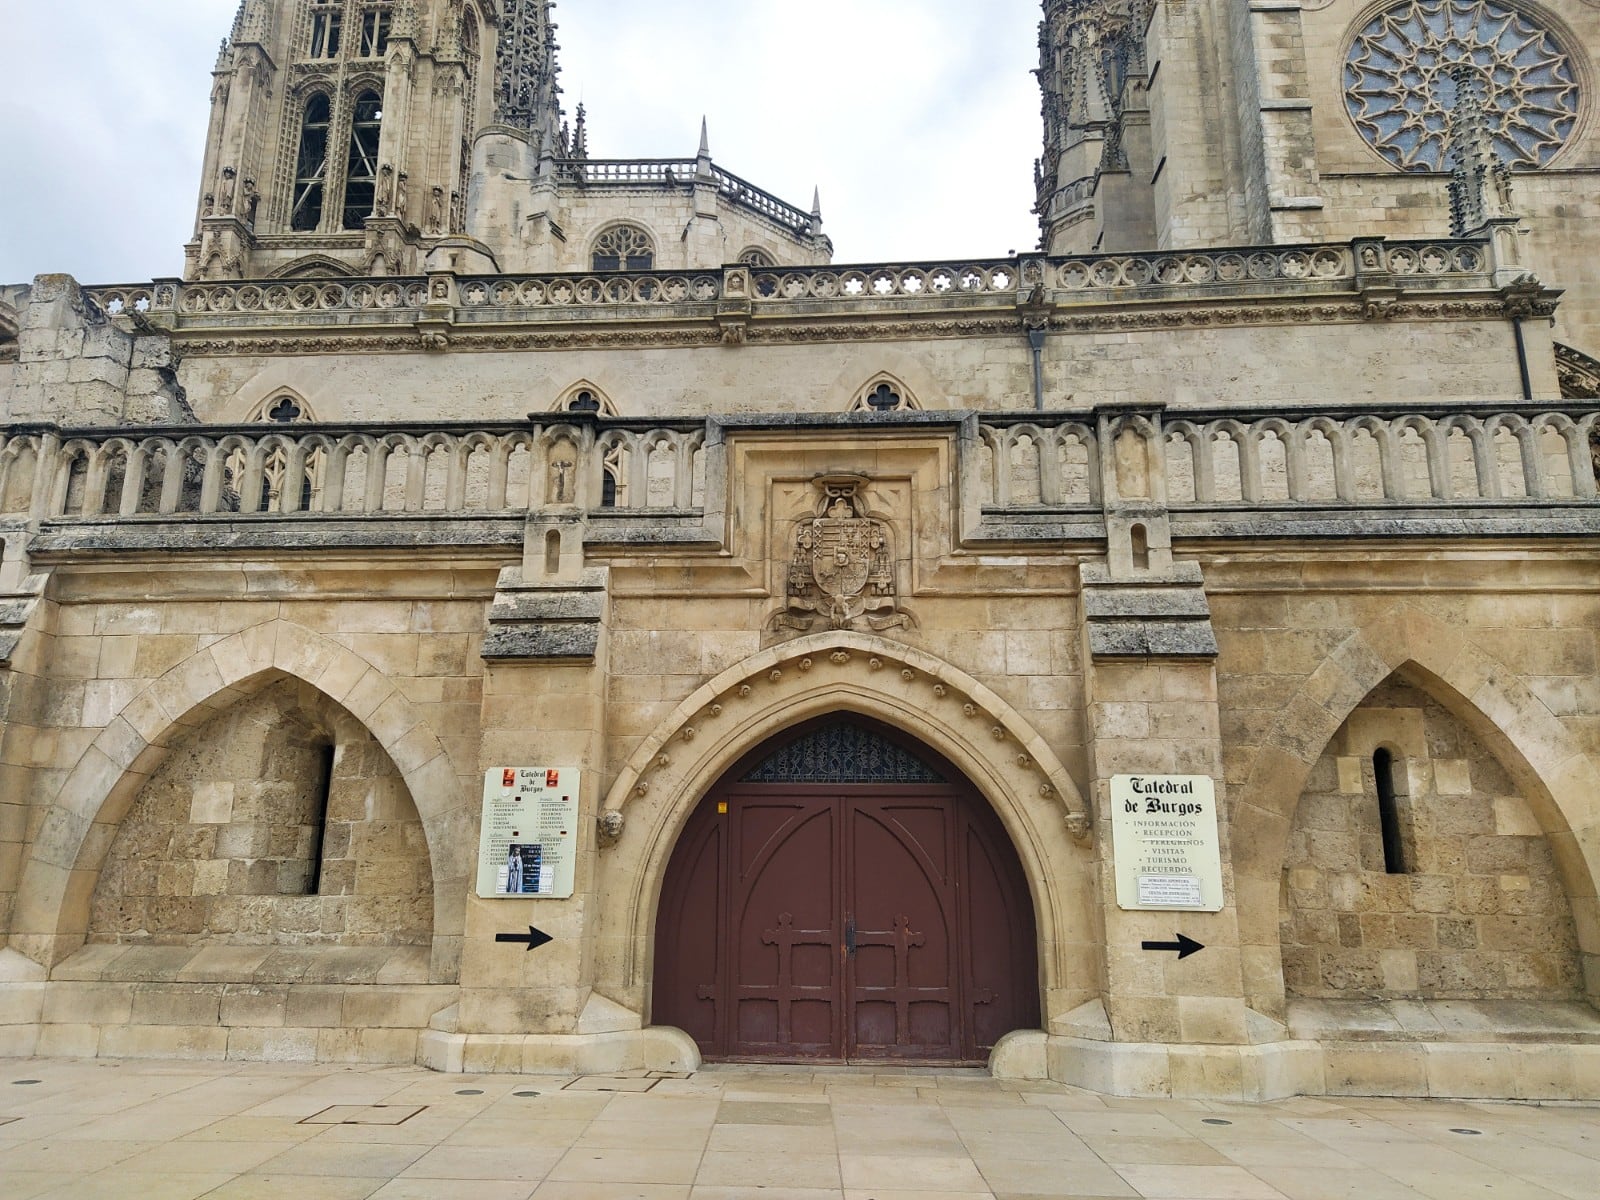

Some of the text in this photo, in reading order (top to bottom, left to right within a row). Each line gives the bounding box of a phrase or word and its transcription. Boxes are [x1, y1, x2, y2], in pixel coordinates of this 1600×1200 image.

[520, 769, 546, 778] Catedral
[520, 785, 543, 794] Burgos
[1130, 777, 1193, 794] Catedral
[1125, 797, 1203, 816] de Burgos
